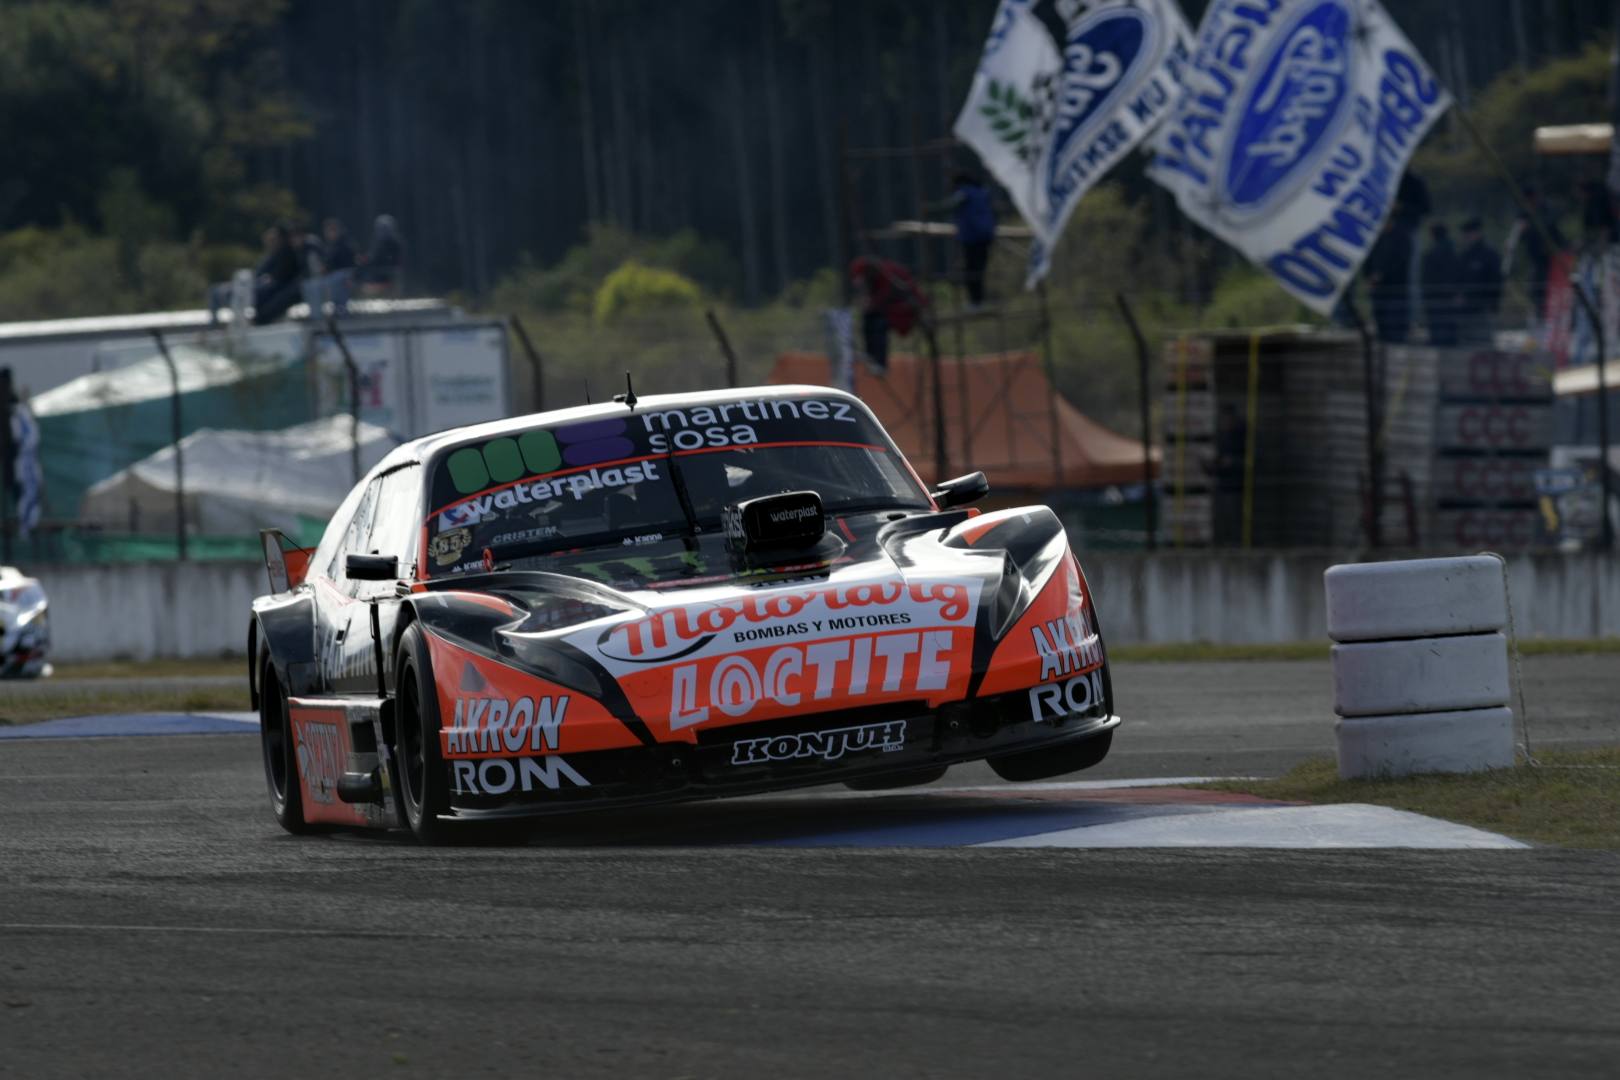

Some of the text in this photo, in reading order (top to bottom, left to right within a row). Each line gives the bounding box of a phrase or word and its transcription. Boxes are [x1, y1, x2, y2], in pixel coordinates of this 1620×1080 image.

[648, 423, 759, 454] sosa
[456, 460, 661, 517] waterplast
[770, 504, 819, 523] waterplast
[733, 611, 912, 644] BOMBAS Y MOTORES
[669, 629, 954, 731] LOCTITE
[447, 694, 570, 754] AKRON
[730, 719, 908, 765] KONJUH
